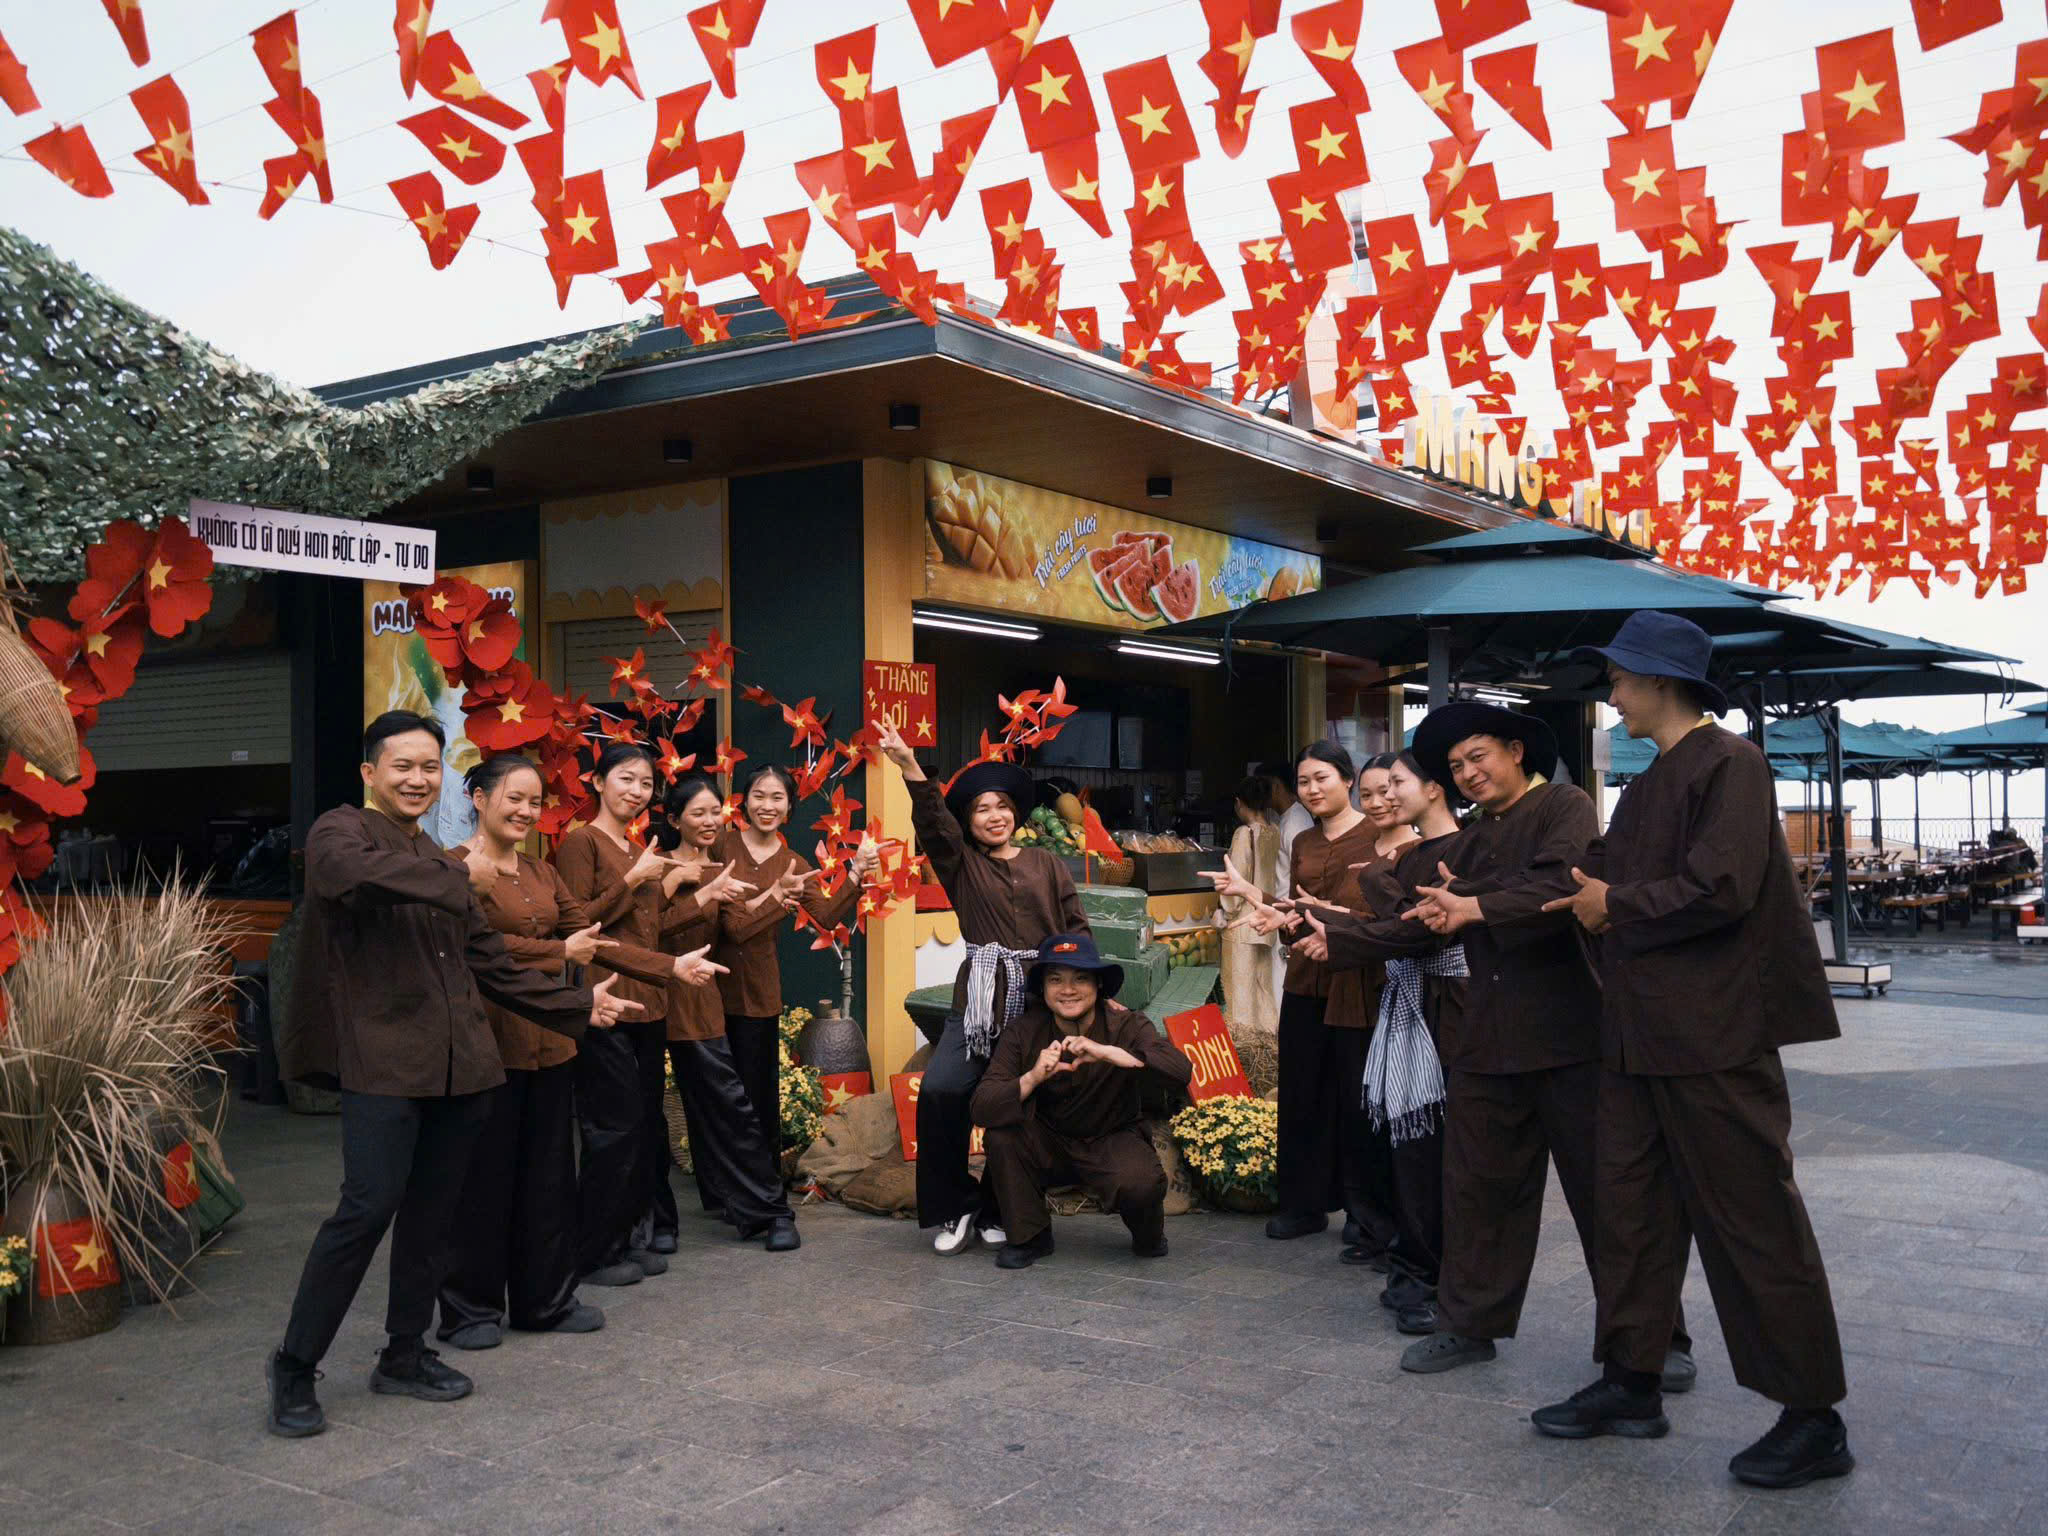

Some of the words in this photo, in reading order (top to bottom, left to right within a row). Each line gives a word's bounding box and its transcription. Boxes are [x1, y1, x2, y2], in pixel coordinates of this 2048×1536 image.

[197, 512, 238, 549] KHÔNG
[242, 518, 257, 551] CÓ
[261, 520, 273, 553] GÌ
[277, 524, 300, 557] QUÝ
[304, 531, 328, 560] HƠN
[332, 529, 356, 565] ĐỘC
[359, 532, 381, 568] LẬP
[394, 541, 411, 572] TỰ
[413, 544, 429, 570] DO
[873, 663, 929, 696] THẮNG
